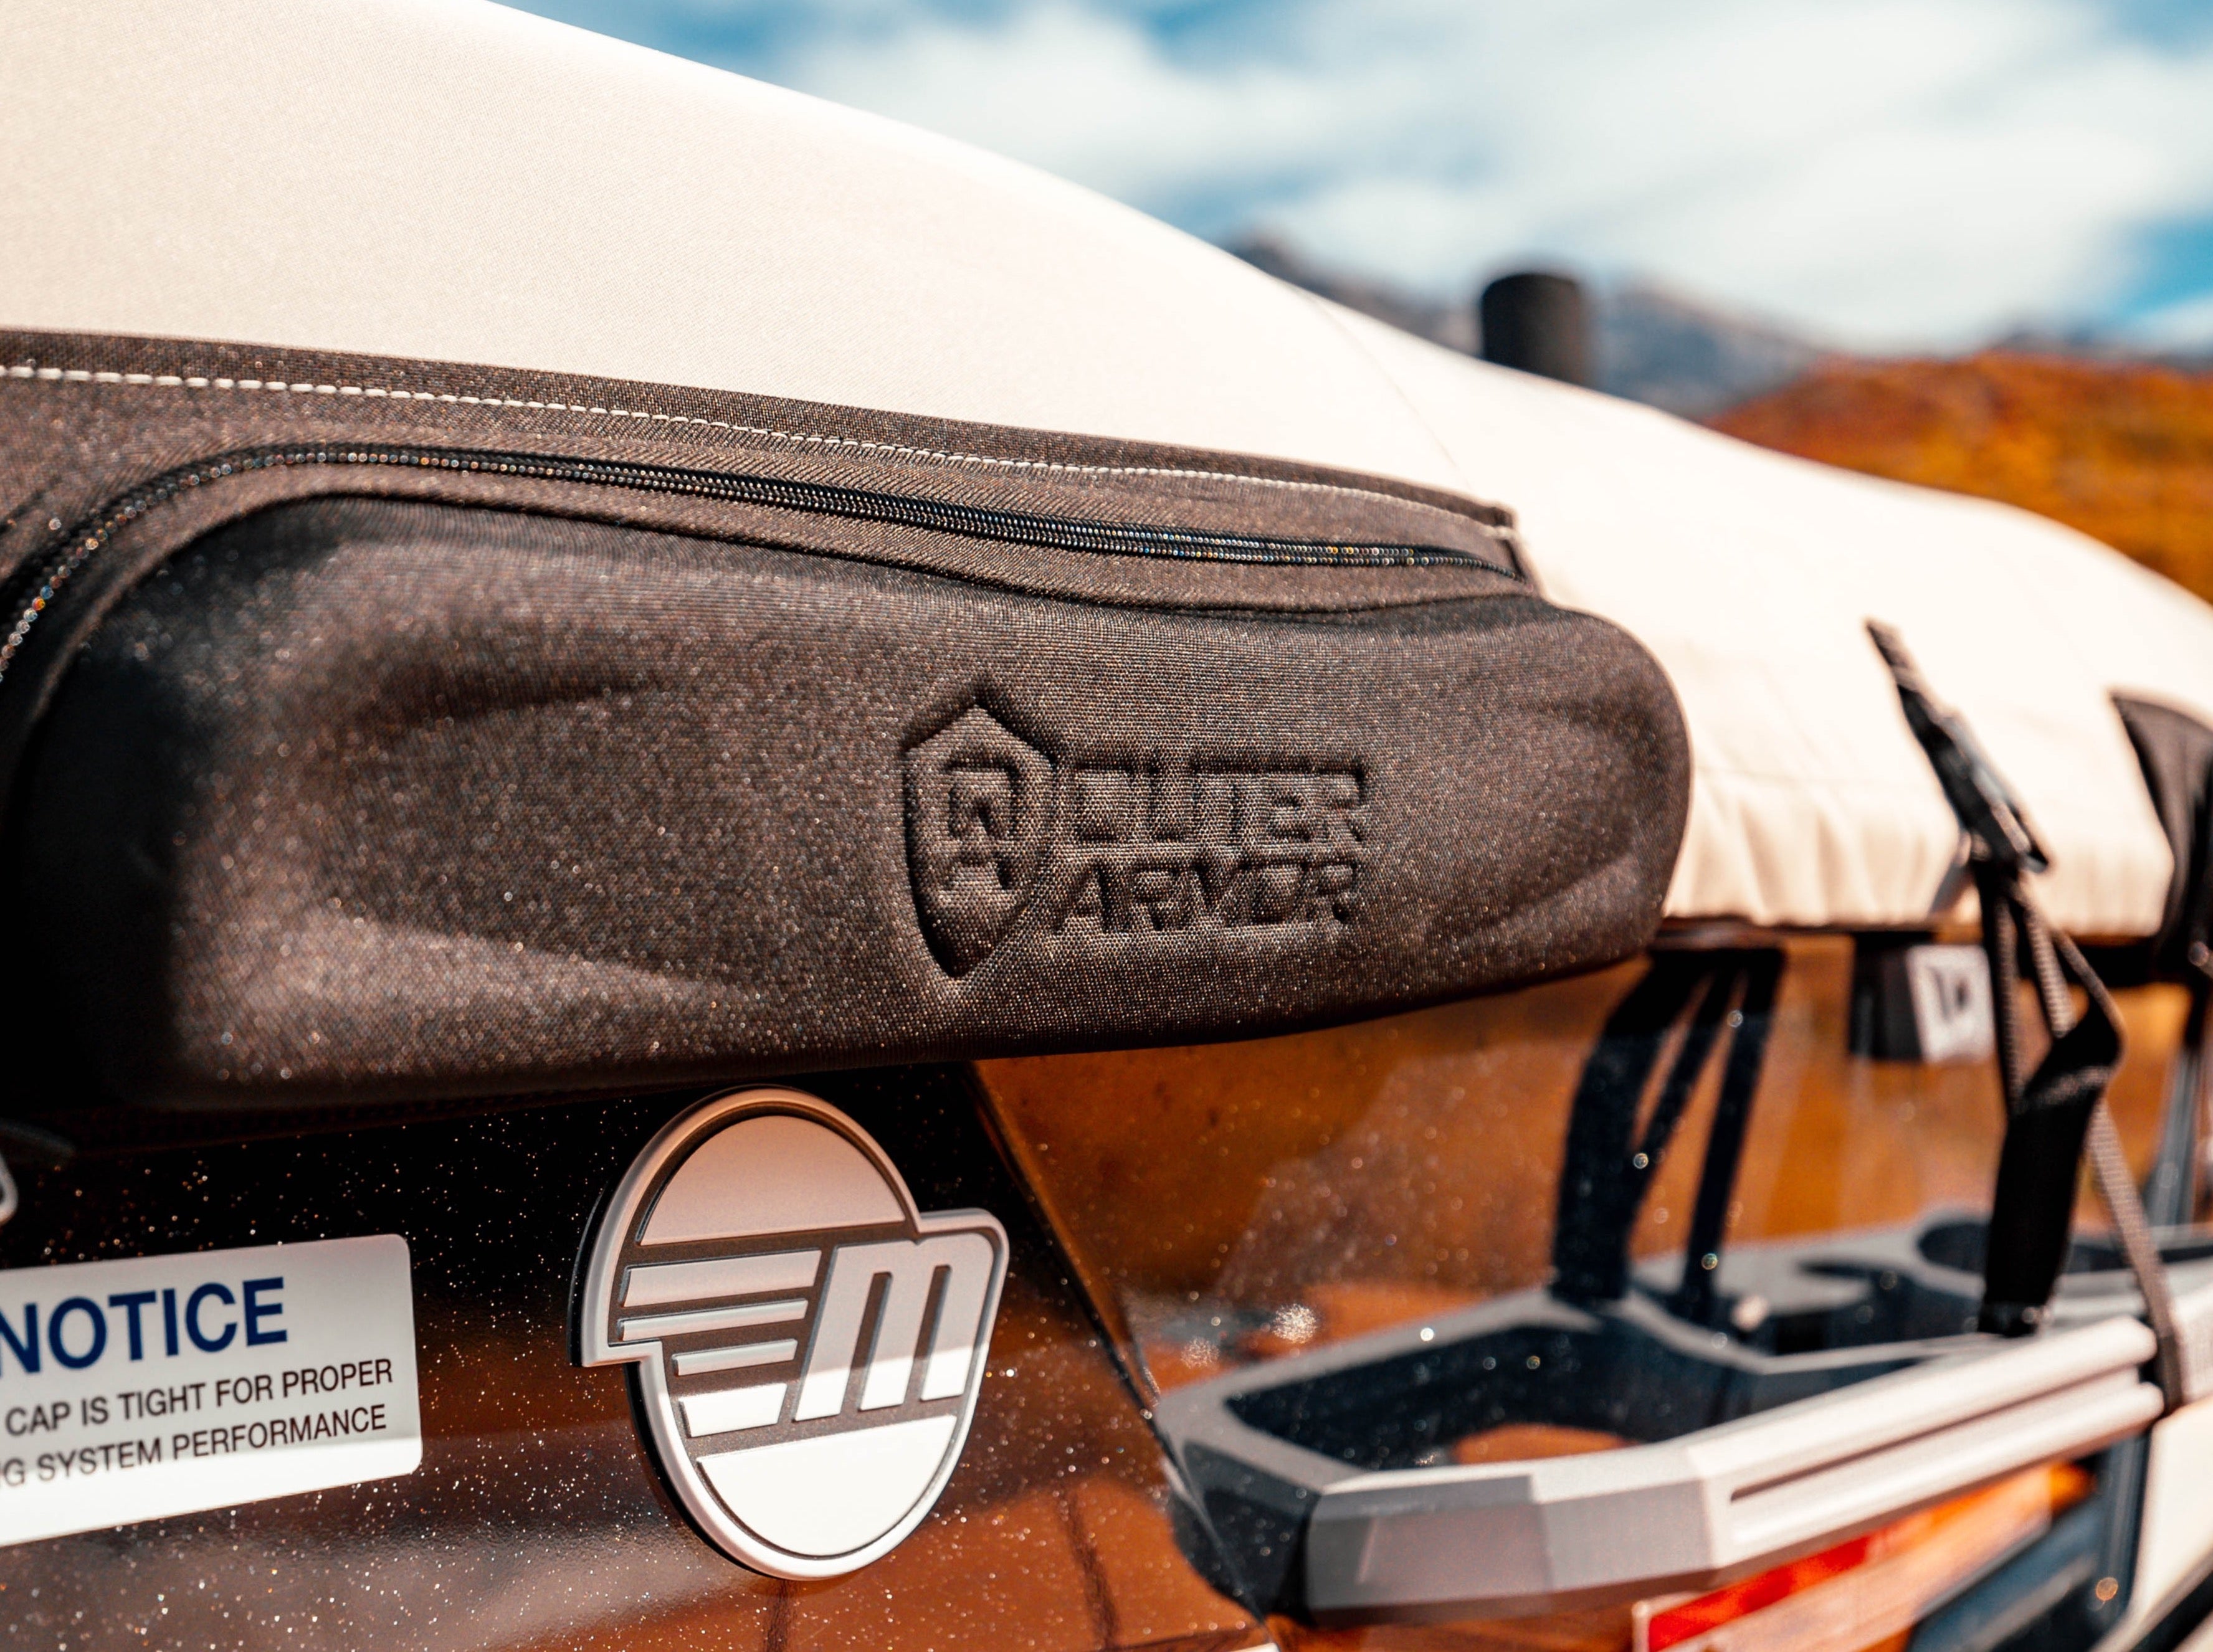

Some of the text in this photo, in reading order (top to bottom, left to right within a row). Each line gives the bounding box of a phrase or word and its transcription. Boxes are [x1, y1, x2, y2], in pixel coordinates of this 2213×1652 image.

[0, 1277, 288, 1378] NOTICE
[5, 1358, 393, 1436] CAP IS TIGHT FOR PROPER
[37, 1437, 163, 1482] SYSTEM
[173, 1403, 387, 1460] PERFORMANCE
